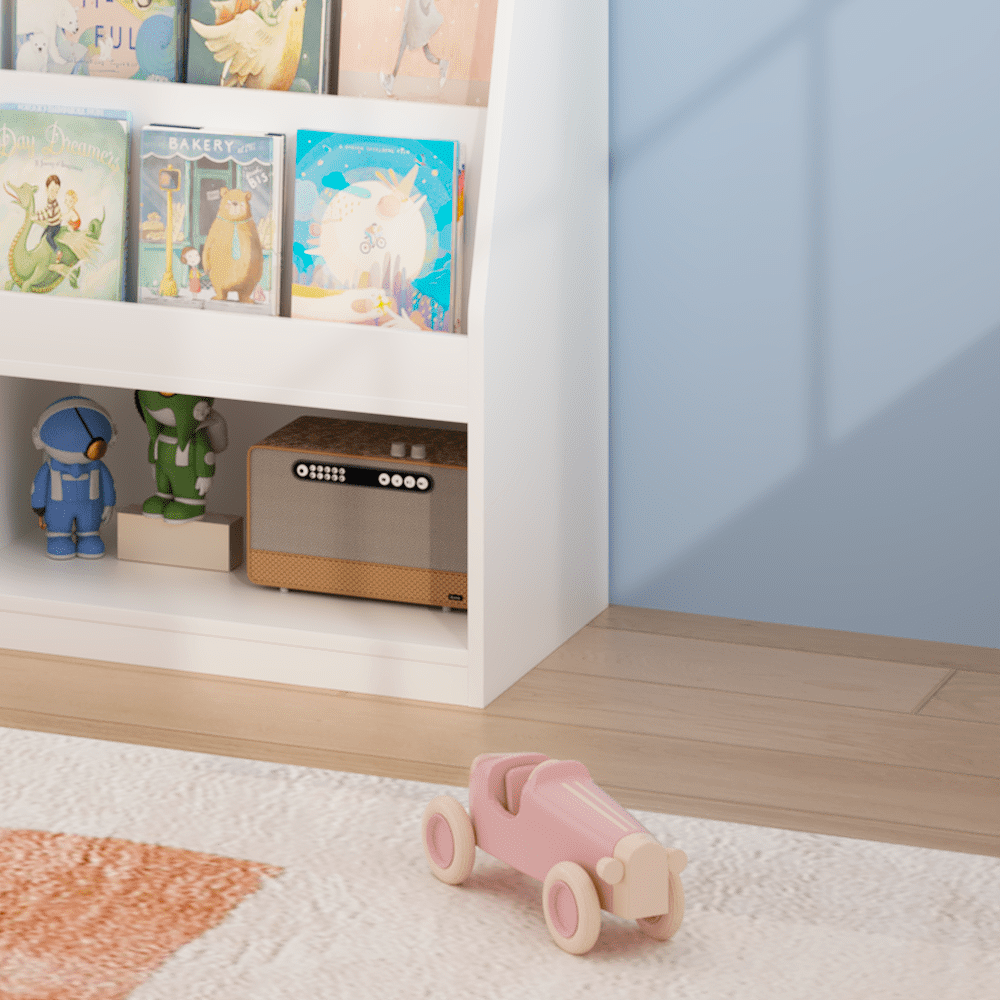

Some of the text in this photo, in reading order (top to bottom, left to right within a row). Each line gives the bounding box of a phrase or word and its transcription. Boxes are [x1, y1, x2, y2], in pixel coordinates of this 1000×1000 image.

[95, 24, 136, 50] FUL
[41, 119, 121, 173] Dreamers
[168, 136, 235, 154] BAKERY
